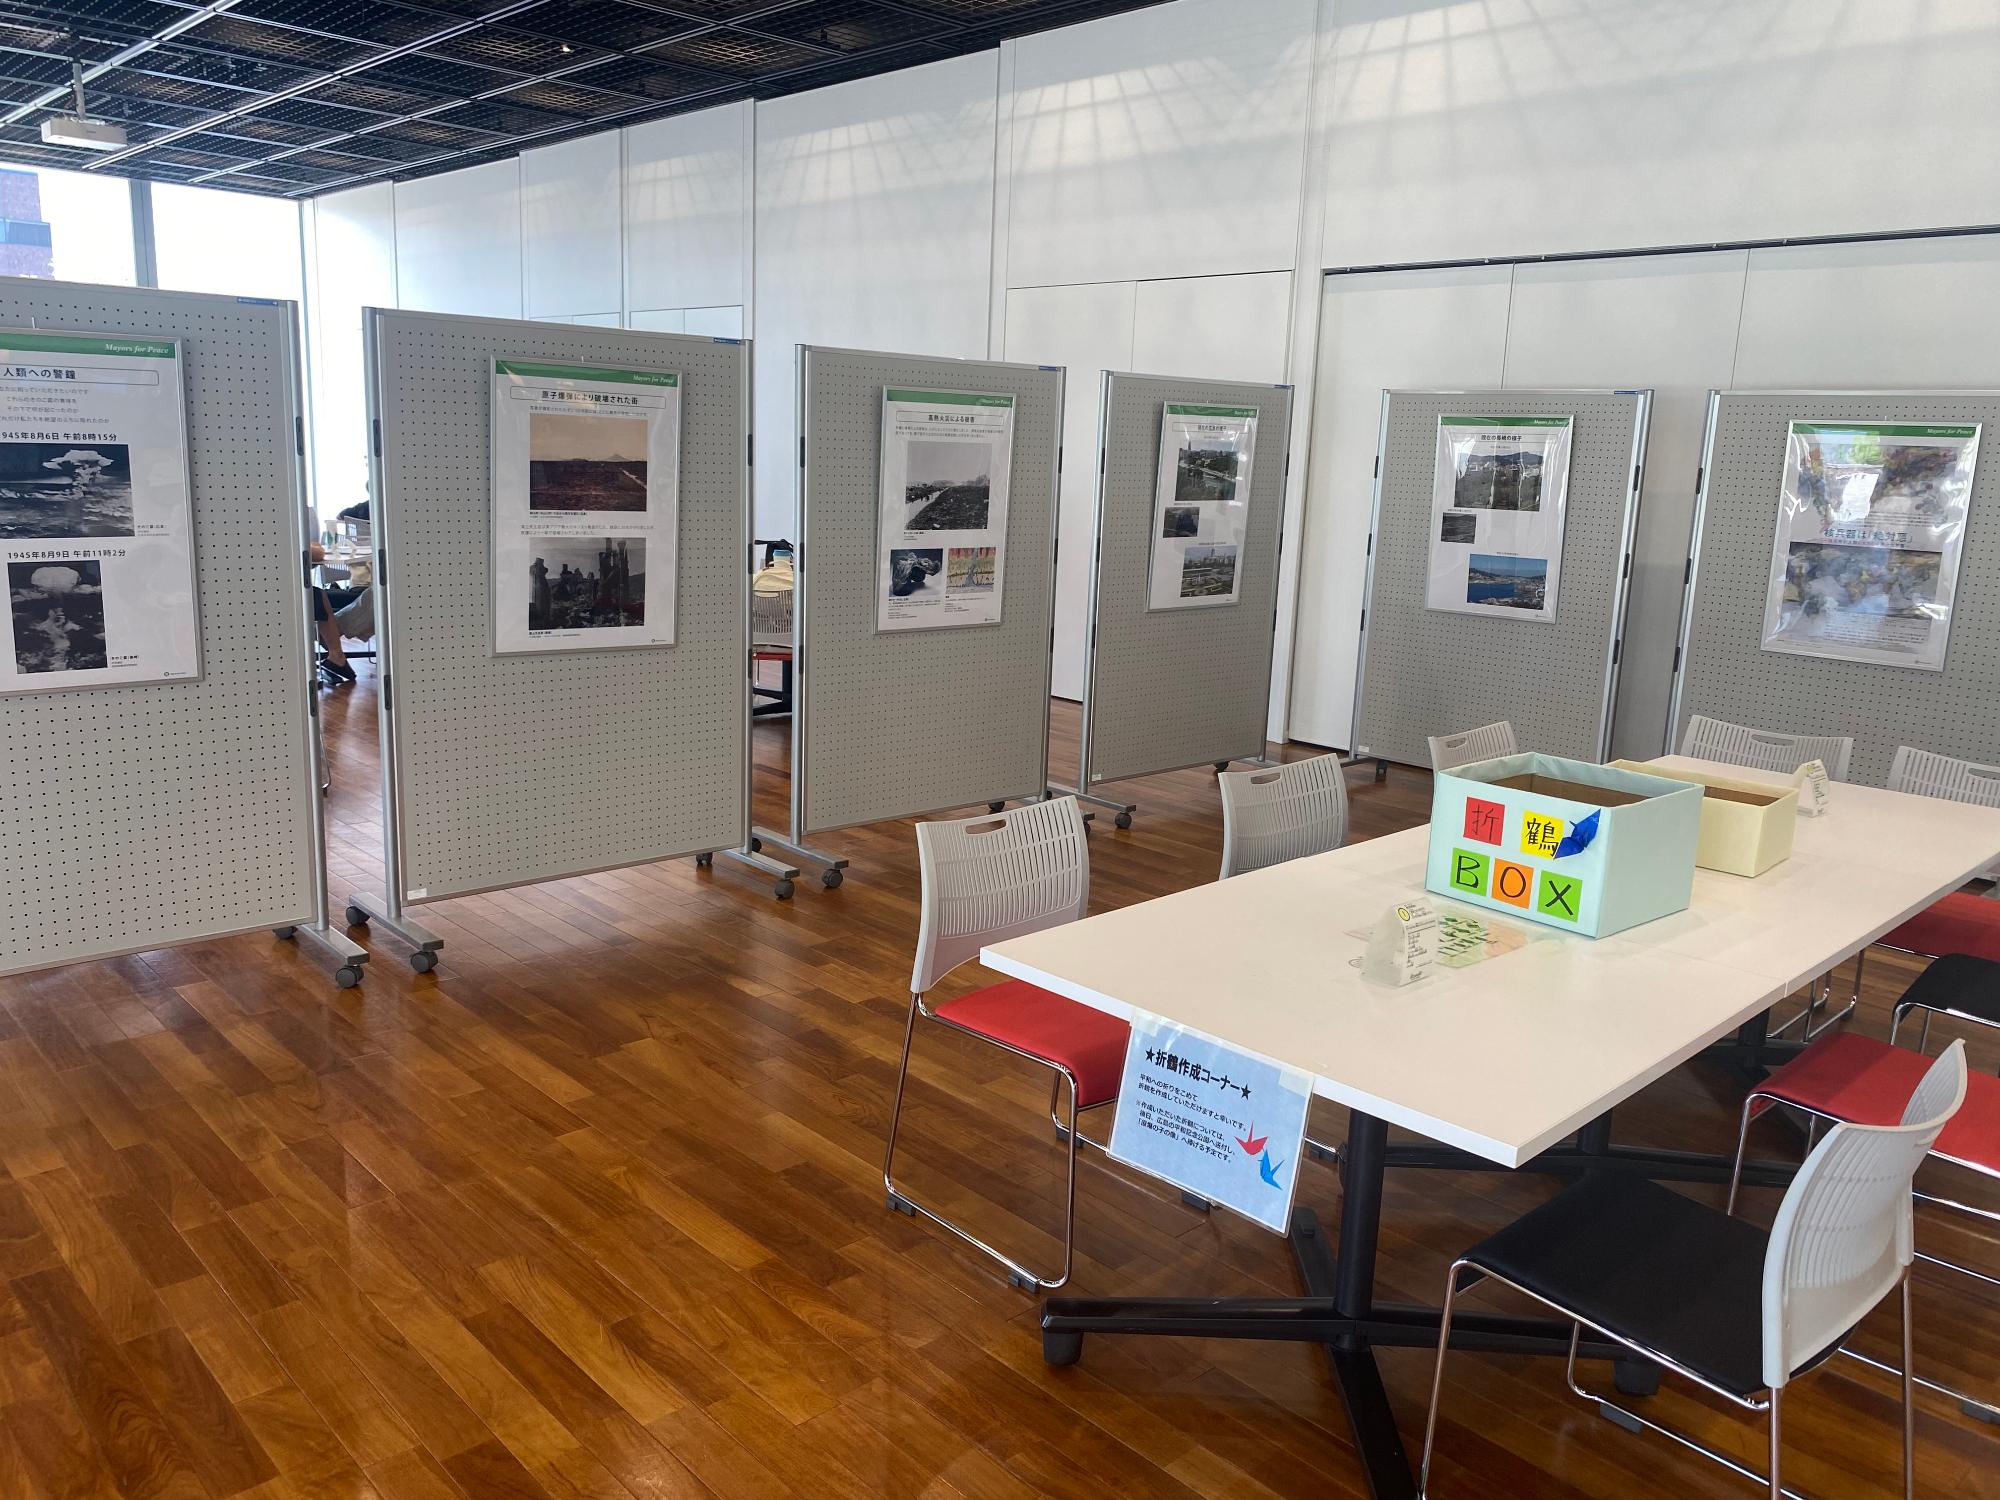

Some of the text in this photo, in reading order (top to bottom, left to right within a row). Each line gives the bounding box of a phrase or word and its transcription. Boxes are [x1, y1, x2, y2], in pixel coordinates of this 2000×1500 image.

[105, 343, 169, 354] Mayors for Peace
[3, 367, 76, 380] 人類への警鐘
[541, 390, 639, 405] 原子爆弾により破壊された街
[63, 432, 117, 442] 午前8時15分
[8, 549, 126, 559] 1945年8月9日 午前11時2分
[1471, 803, 1559, 858] 折鶴
[1456, 855, 1574, 916] BOX
[1139, 1073, 1198, 1102] 平和への祈りをこめて
